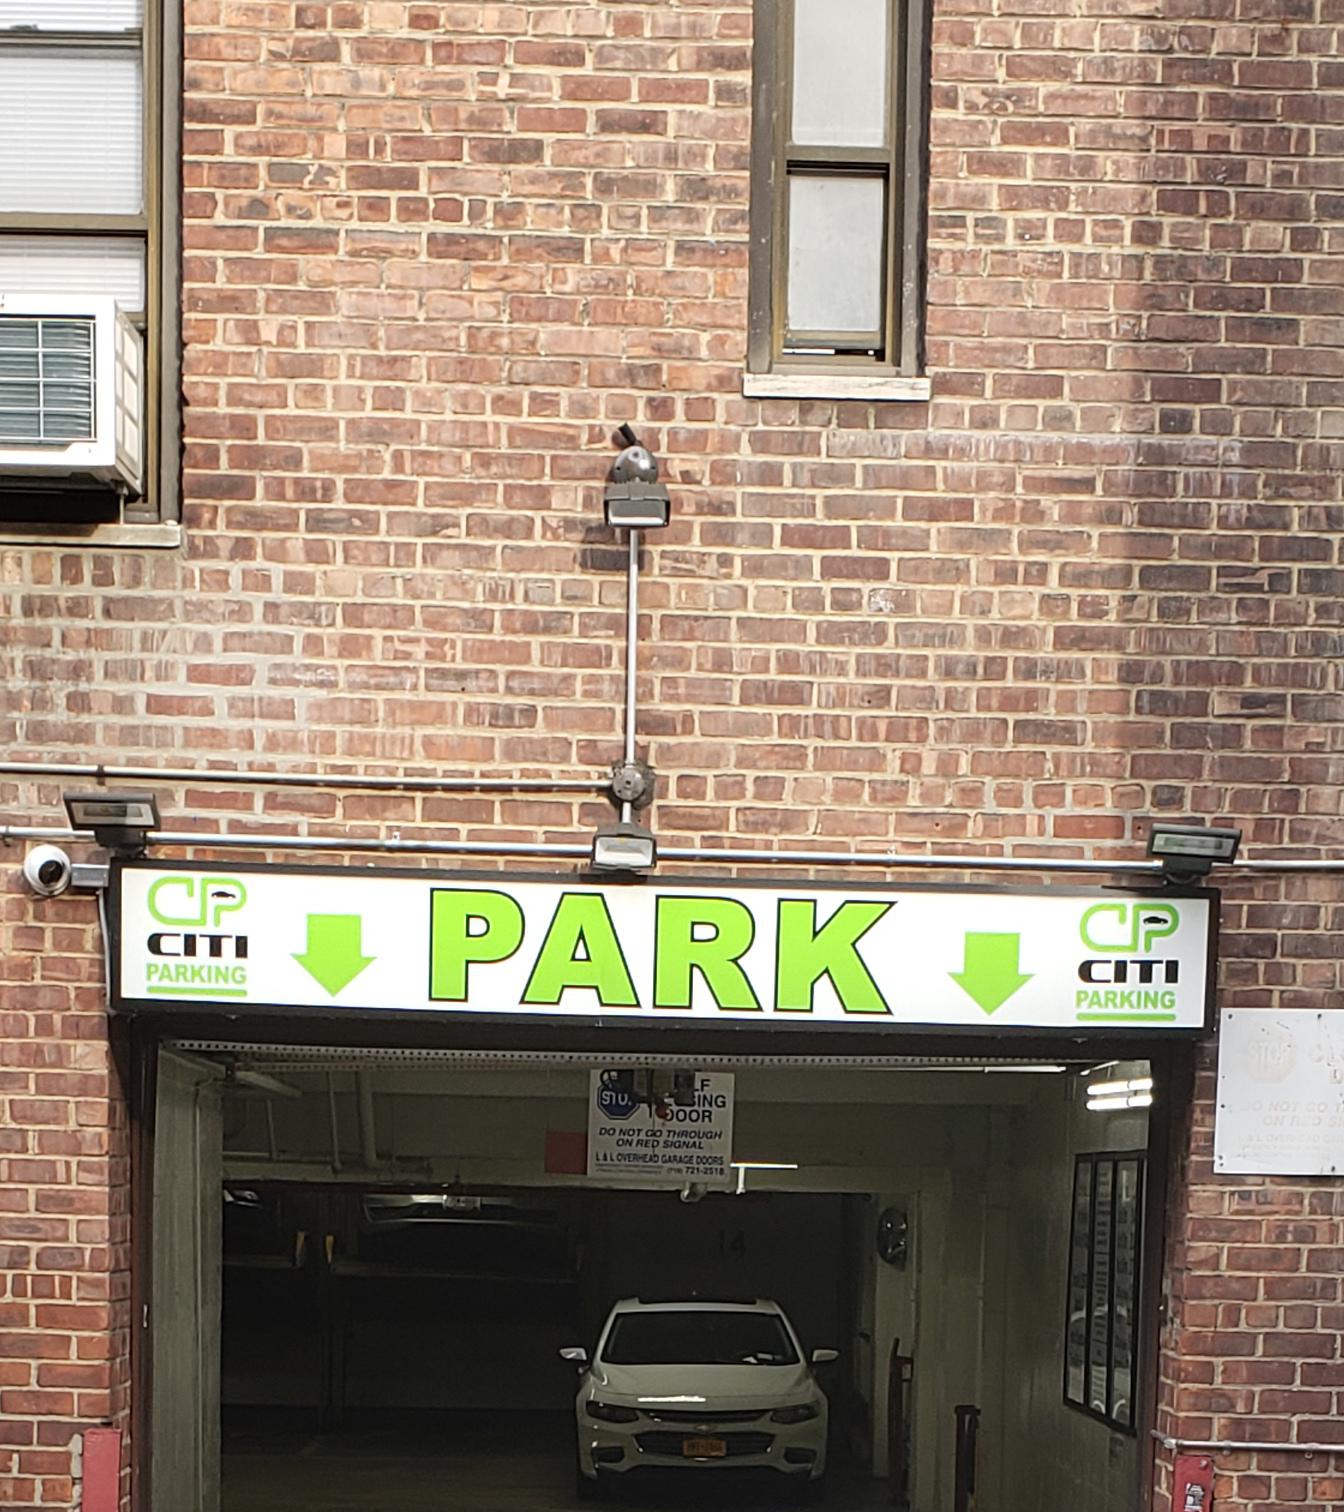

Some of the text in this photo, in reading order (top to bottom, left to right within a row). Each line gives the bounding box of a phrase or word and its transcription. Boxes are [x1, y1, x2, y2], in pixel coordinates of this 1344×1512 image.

[147, 932, 248, 958] CITI
[429, 887, 898, 1015] PARK
[146, 962, 247, 985] PARKING
[1078, 959, 1179, 984] CITI
[1075, 989, 1177, 1010] PARKING
[599, 1127, 723, 1140] DO NOT GO THROUGH
[616, 1138, 704, 1150] ON RED SIGNAL
[616, 1153, 660, 1163] OVERHEAD
[661, 1154, 694, 1165] GARAGE
[696, 1155, 724, 1166] DOORS
